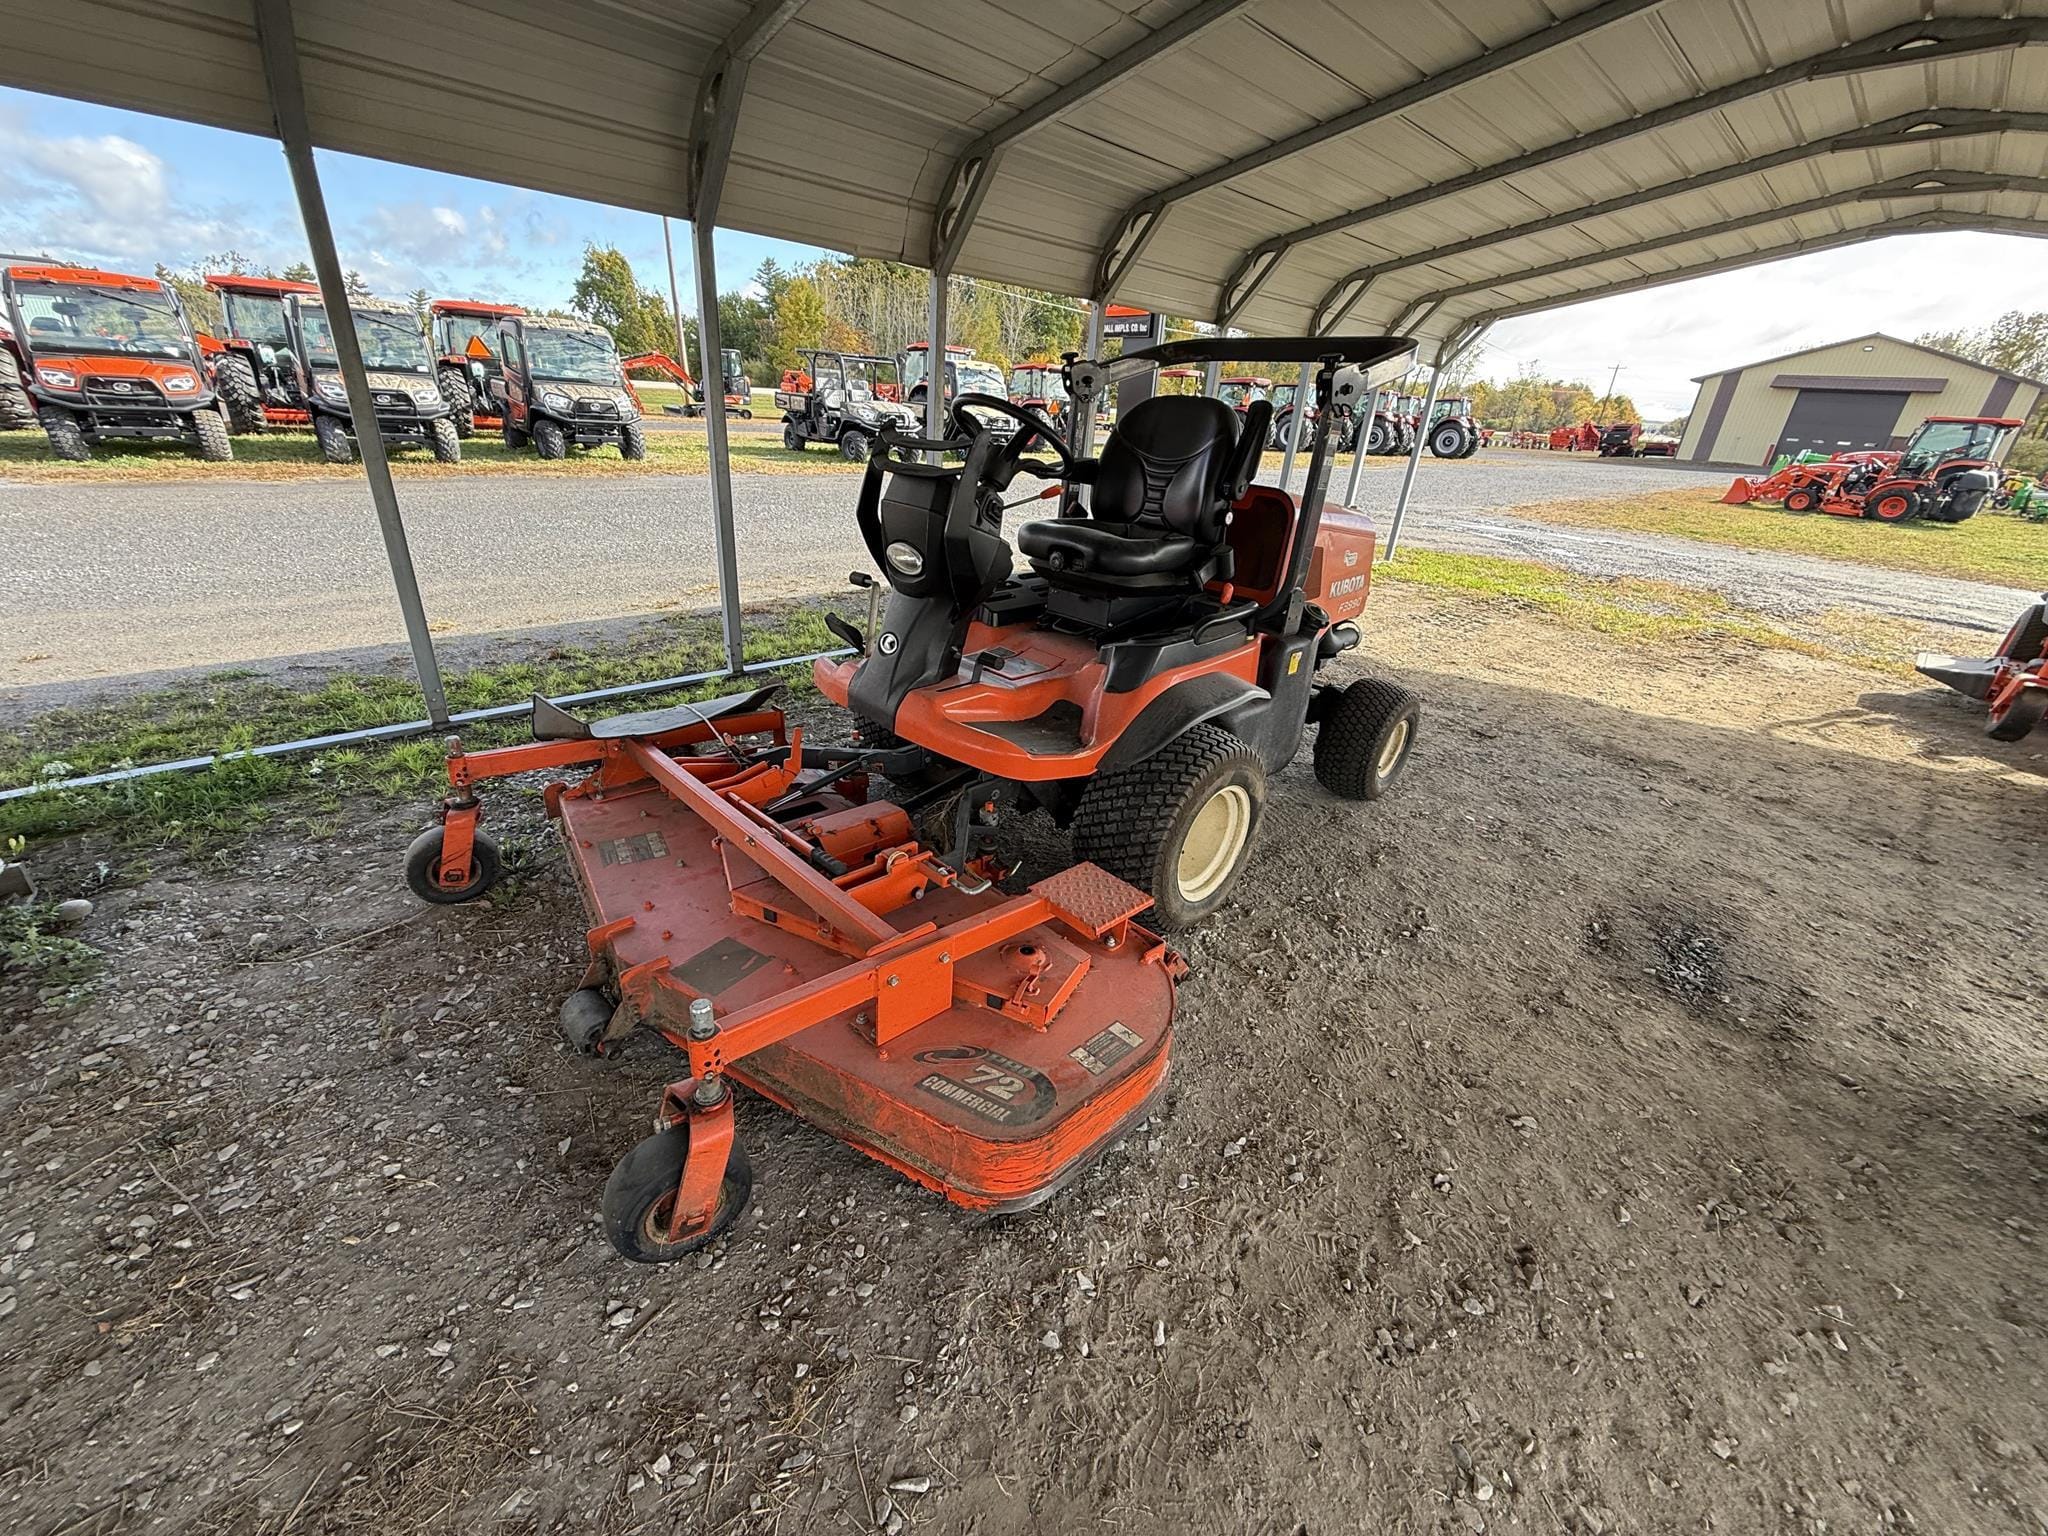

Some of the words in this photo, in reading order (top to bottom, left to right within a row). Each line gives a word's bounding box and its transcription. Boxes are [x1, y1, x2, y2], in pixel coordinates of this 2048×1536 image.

[1329, 574, 1365, 599] KUBOTA
[921, 1075, 1012, 1123] COMMERCIAL
[963, 1064, 1026, 1101] 72
